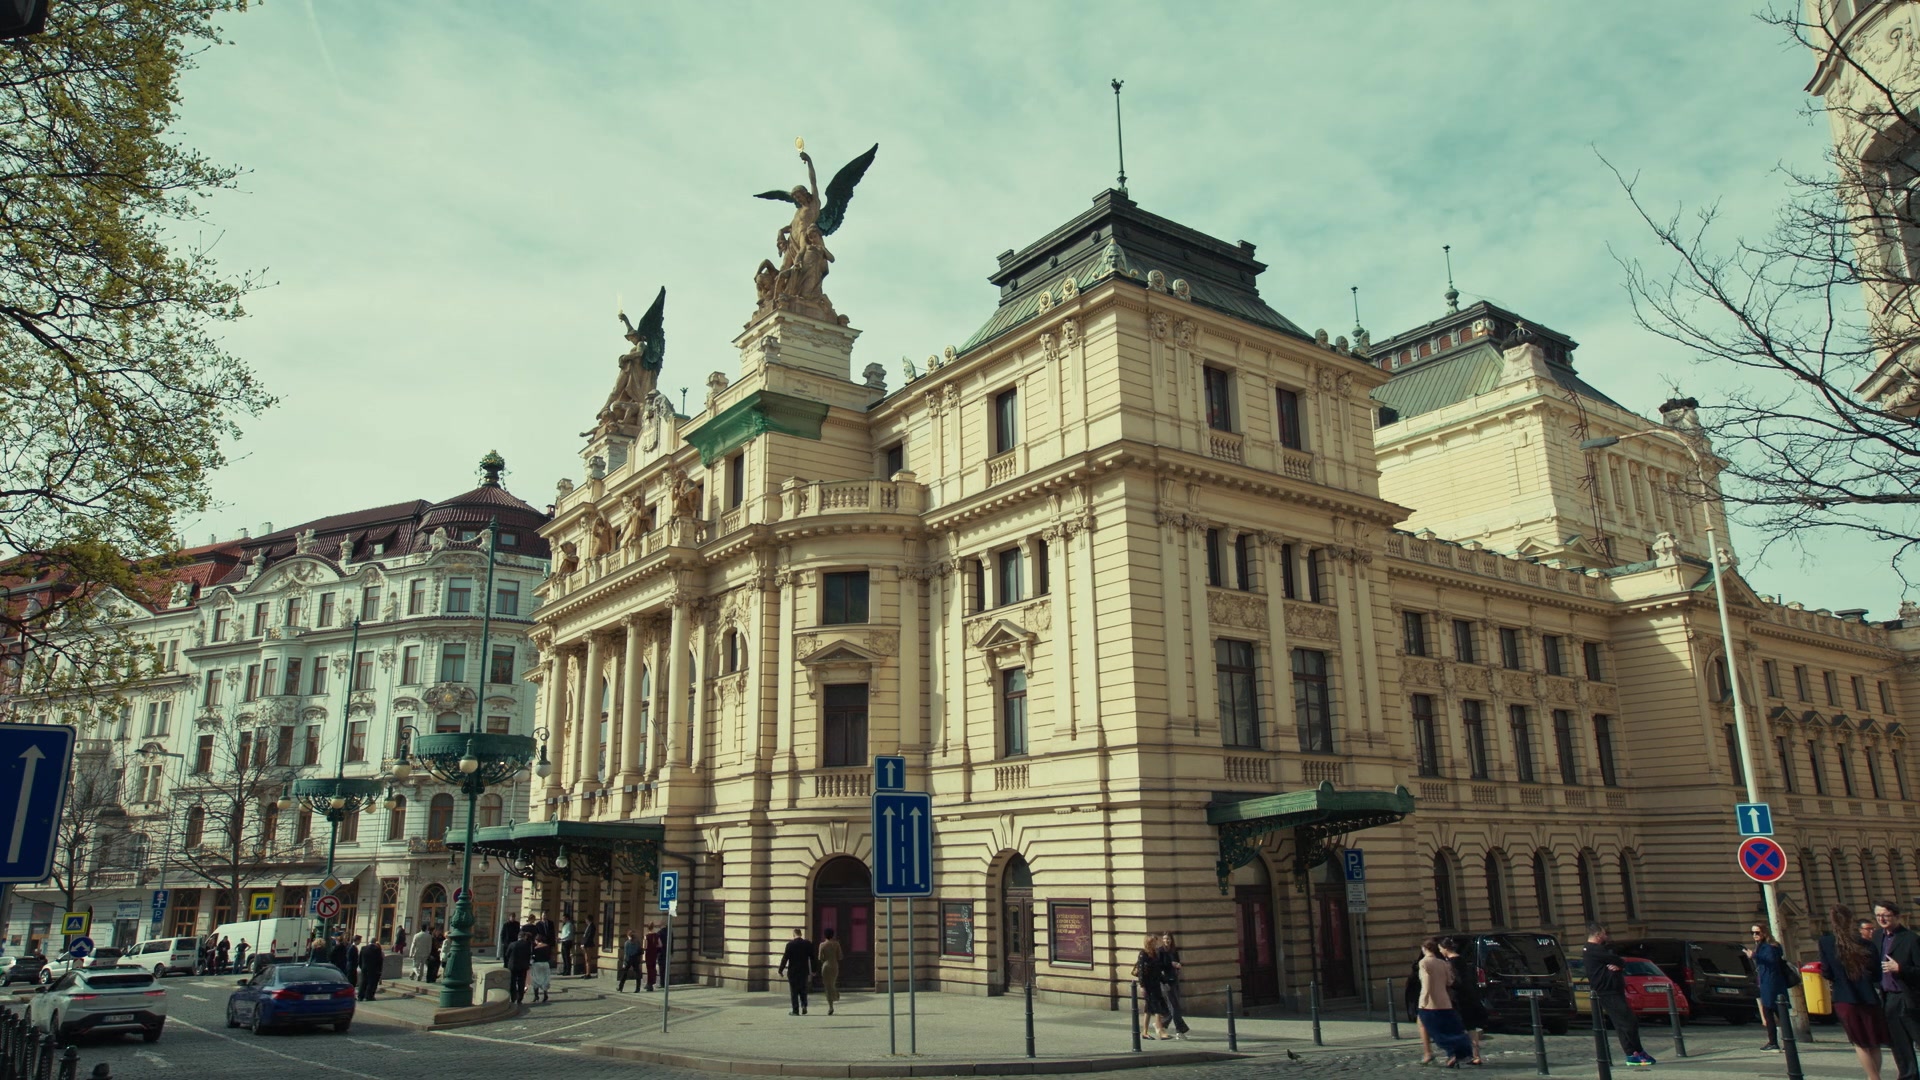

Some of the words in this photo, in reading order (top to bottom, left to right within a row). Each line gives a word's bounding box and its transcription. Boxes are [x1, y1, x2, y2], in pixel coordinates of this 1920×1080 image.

[1347, 853, 1359, 871] P
[663, 876, 674, 898] P
[1537, 938, 1550, 946] VIP
